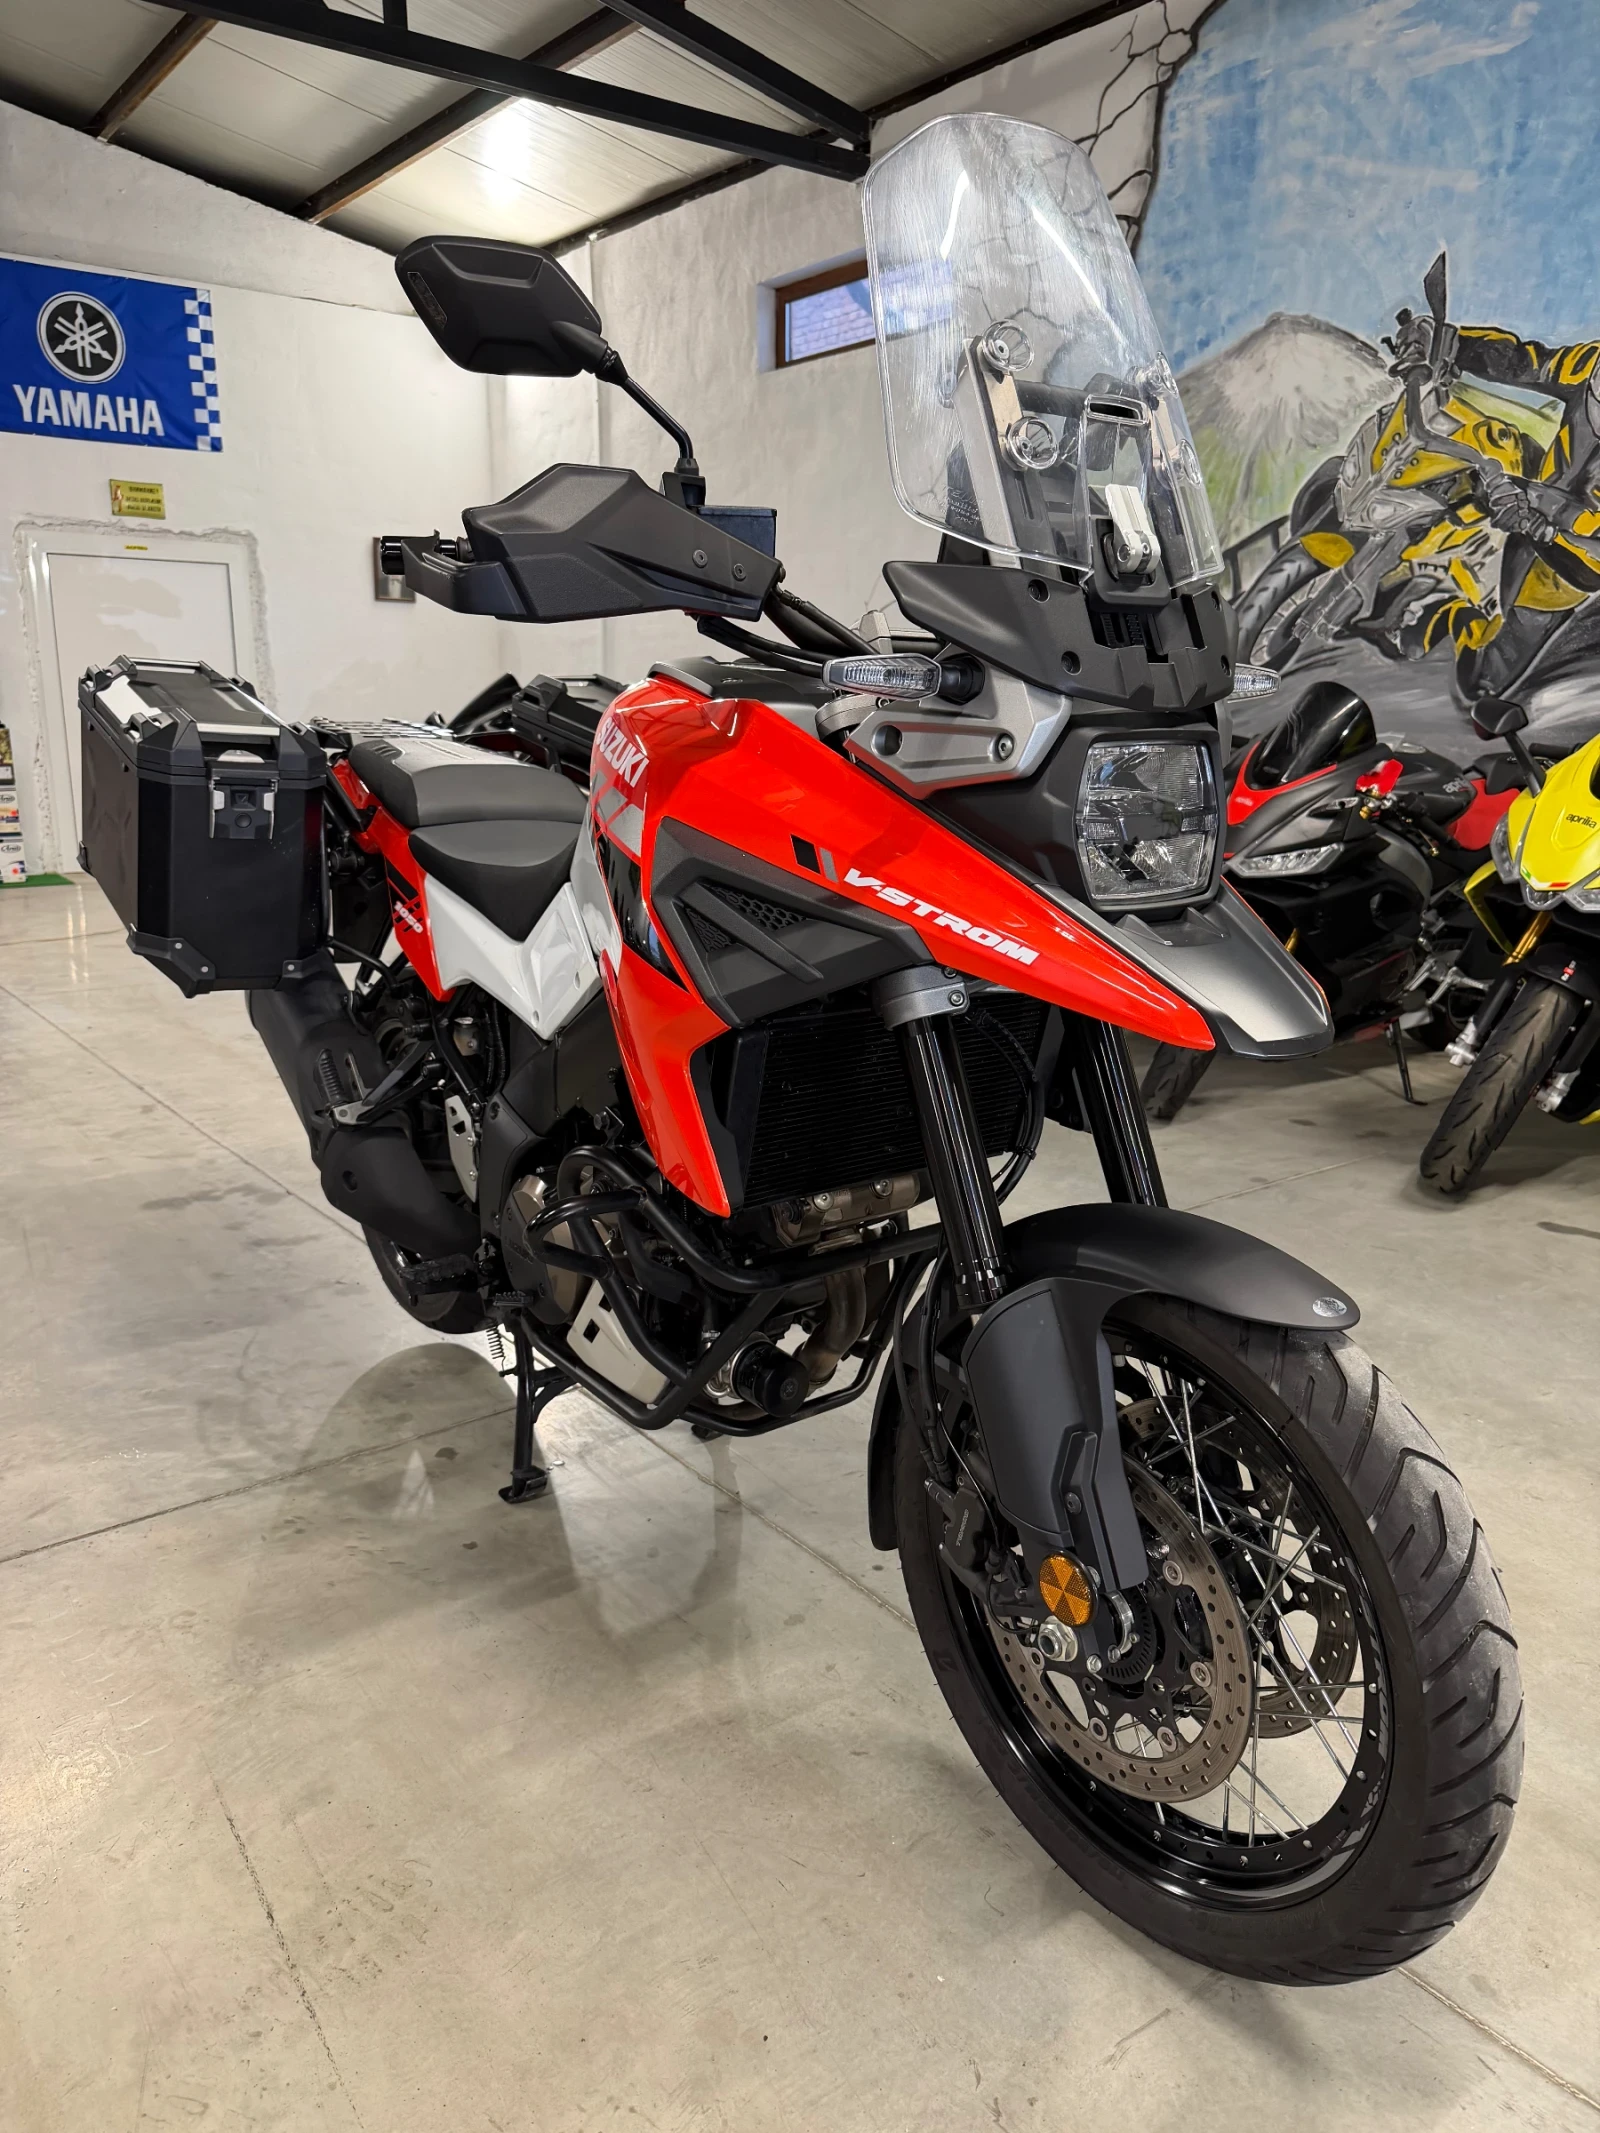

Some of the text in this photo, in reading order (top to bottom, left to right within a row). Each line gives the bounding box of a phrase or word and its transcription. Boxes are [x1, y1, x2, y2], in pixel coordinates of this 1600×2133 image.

[12, 384, 165, 436] YAMAHA
[596, 716, 650, 788] SUZUKI
[1566, 813, 1598, 829] aprilia
[394, 900, 424, 934] 1050
[843, 867, 1041, 966] V-STROM
